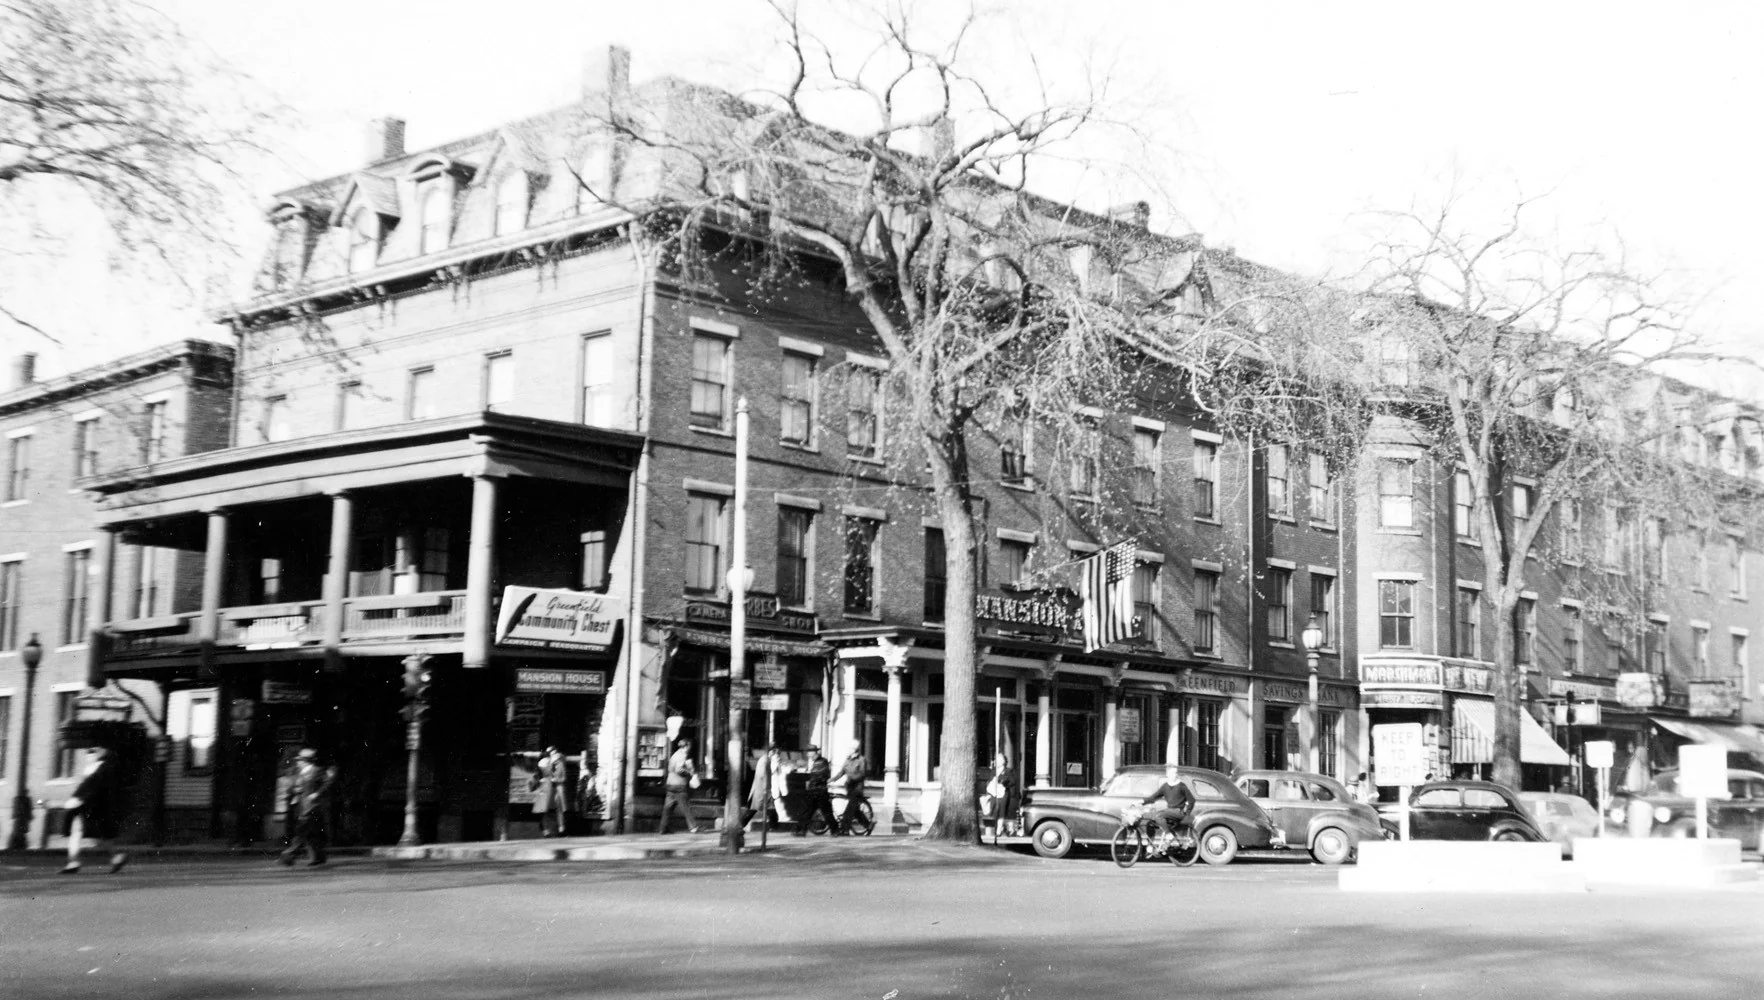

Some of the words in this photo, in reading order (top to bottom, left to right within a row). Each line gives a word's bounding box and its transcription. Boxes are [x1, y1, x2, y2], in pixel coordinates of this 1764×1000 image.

[546, 596, 603, 616] Greenfield
[688, 606, 727, 619] CAMERA
[746, 597, 776, 618] RBES
[519, 611, 578, 636] Community
[581, 612, 611, 633] Chest
[781, 616, 813, 629] SHOP
[501, 638, 546, 647] CAMPAIGN
[549, 641, 606, 652] HEADQUARTERS
[745, 642, 788, 653] AMERA
[792, 646, 821, 655] SHOP
[517, 671, 562, 683] MANSION
[564, 673, 600, 684] HOUSE
[1187, 675, 1236, 693] EENFIELD
[1262, 684, 1304, 699] SAVINGS
[1317, 688, 1340, 702] ANK
[1381, 731, 1413, 745] KEEP
[1391, 748, 1406, 761] TO
[1380, 765, 1417, 779] RIGHT
